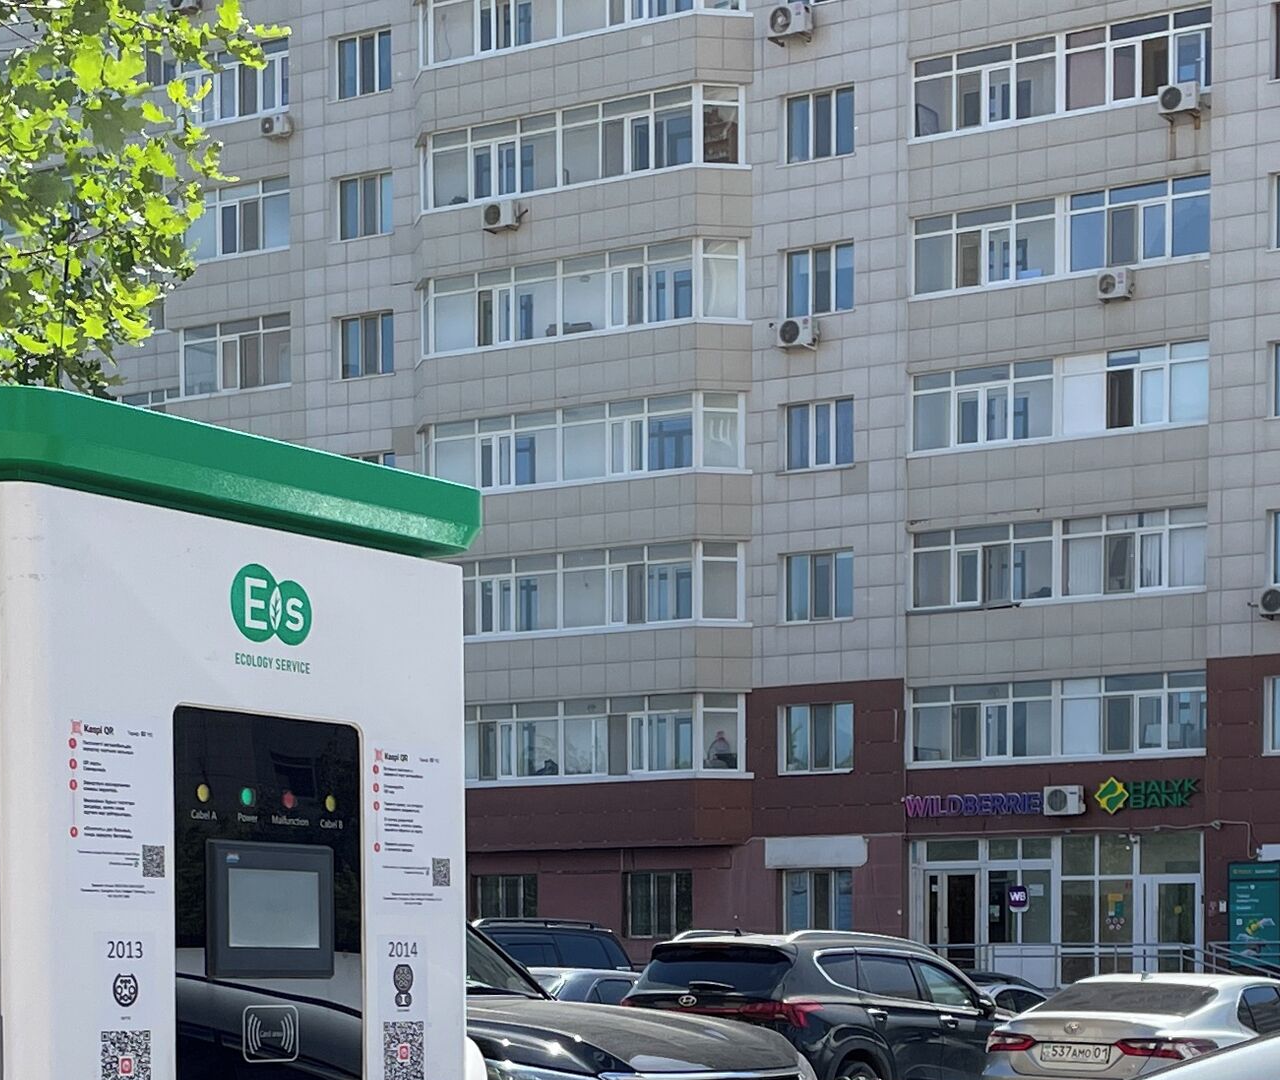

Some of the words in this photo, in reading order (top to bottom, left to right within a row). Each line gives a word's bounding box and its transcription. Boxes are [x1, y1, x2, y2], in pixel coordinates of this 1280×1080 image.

[234, 652, 273, 670] ECOLOGY
[276, 658, 311, 675] SERVICE
[83, 723, 102, 736] Kaspi
[1129, 777, 1199, 794] HALYK
[904, 792, 1041, 818] WILDBERRIE
[1129, 793, 1191, 809] BANK
[211, 811, 218, 821] A
[237, 812, 258, 824] Power
[271, 814, 310, 827] Malfunction
[338, 820, 344, 830] B
[1009, 891, 1027, 901] WB
[107, 940, 144, 959] 2013
[388, 941, 419, 958] 2014
